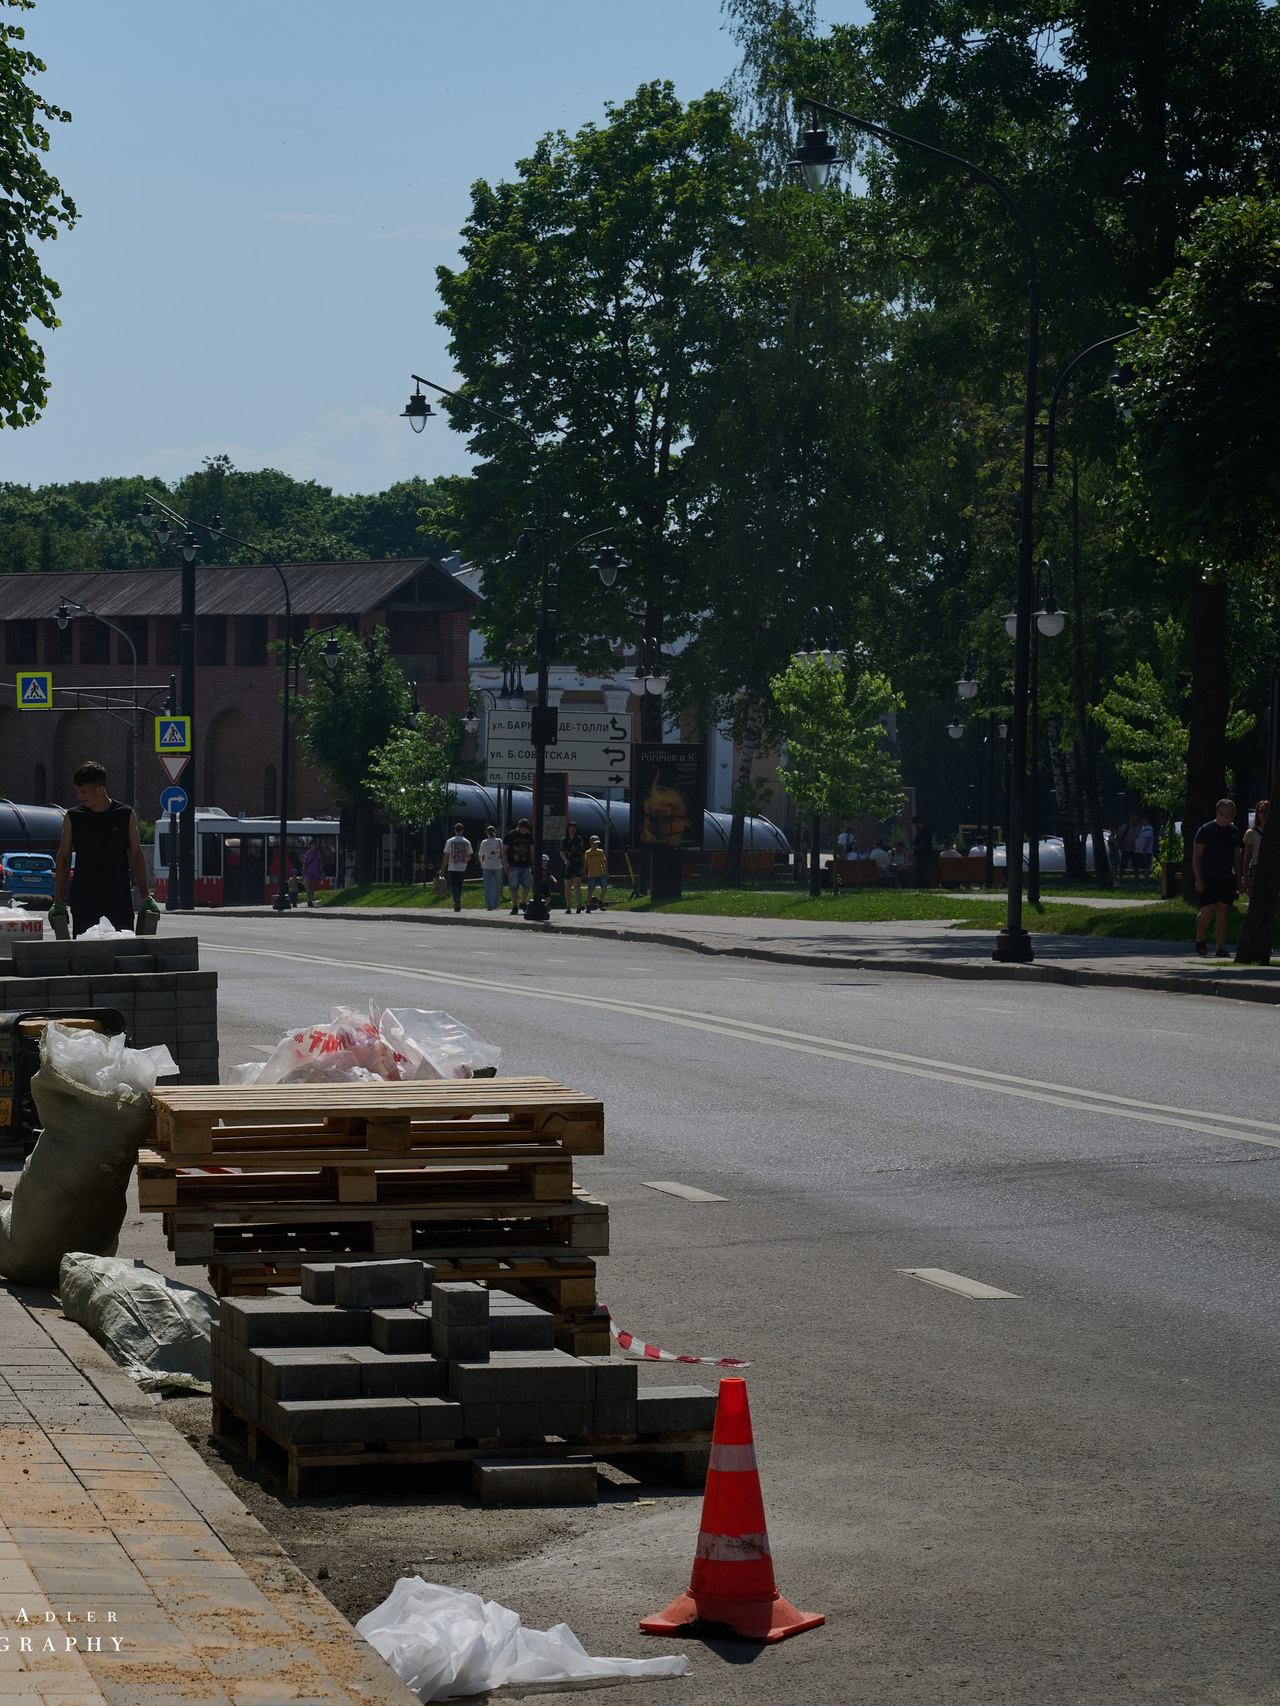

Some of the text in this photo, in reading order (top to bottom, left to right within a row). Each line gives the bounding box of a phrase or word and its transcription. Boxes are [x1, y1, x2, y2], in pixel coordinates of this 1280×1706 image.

[491, 721, 609, 732] ул. БАРК-ДЕ-ТОЛЛИ
[490, 750, 577, 760] ул. Б.СОВТСКАЯ
[640, 752, 678, 762] Рогачев
[679, 754, 686, 762] и
[489, 773, 503, 781] пл.
